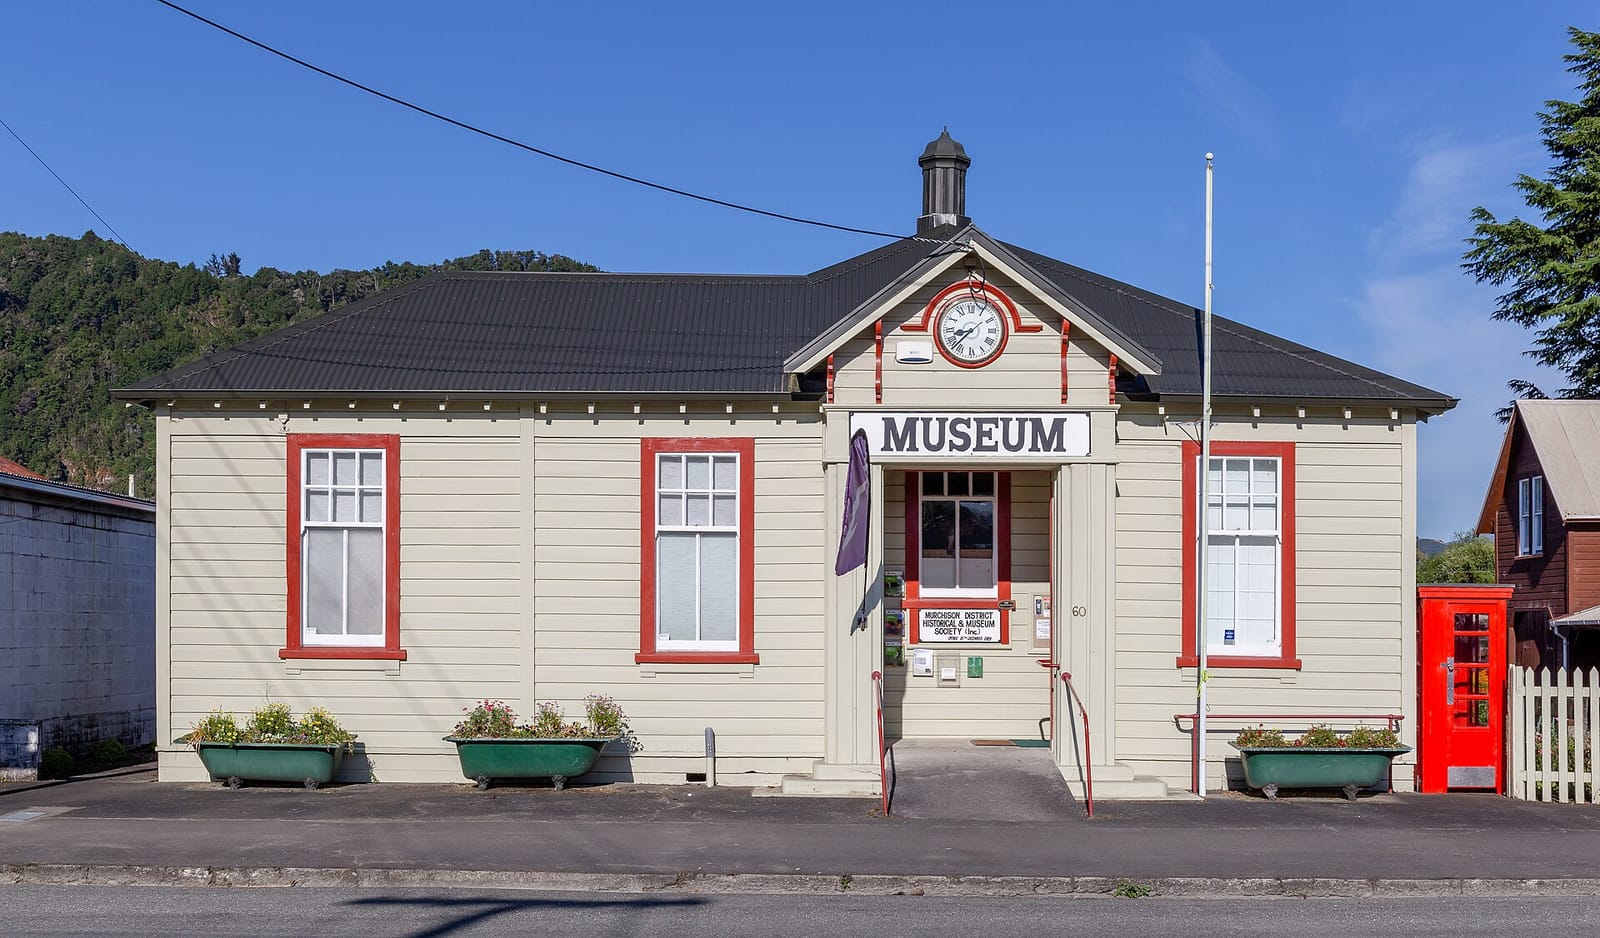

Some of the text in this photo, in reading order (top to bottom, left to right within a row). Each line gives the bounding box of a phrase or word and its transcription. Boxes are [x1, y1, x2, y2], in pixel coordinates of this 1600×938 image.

[880, 417, 1067, 452] MUSEUM
[925, 611, 993, 619] MURCHISON DISTRICT
[1072, 605, 1087, 618] 60
[923, 619, 995, 628] HISTORICAL & MUSEUM
[934, 627, 962, 635] SOCIETY
